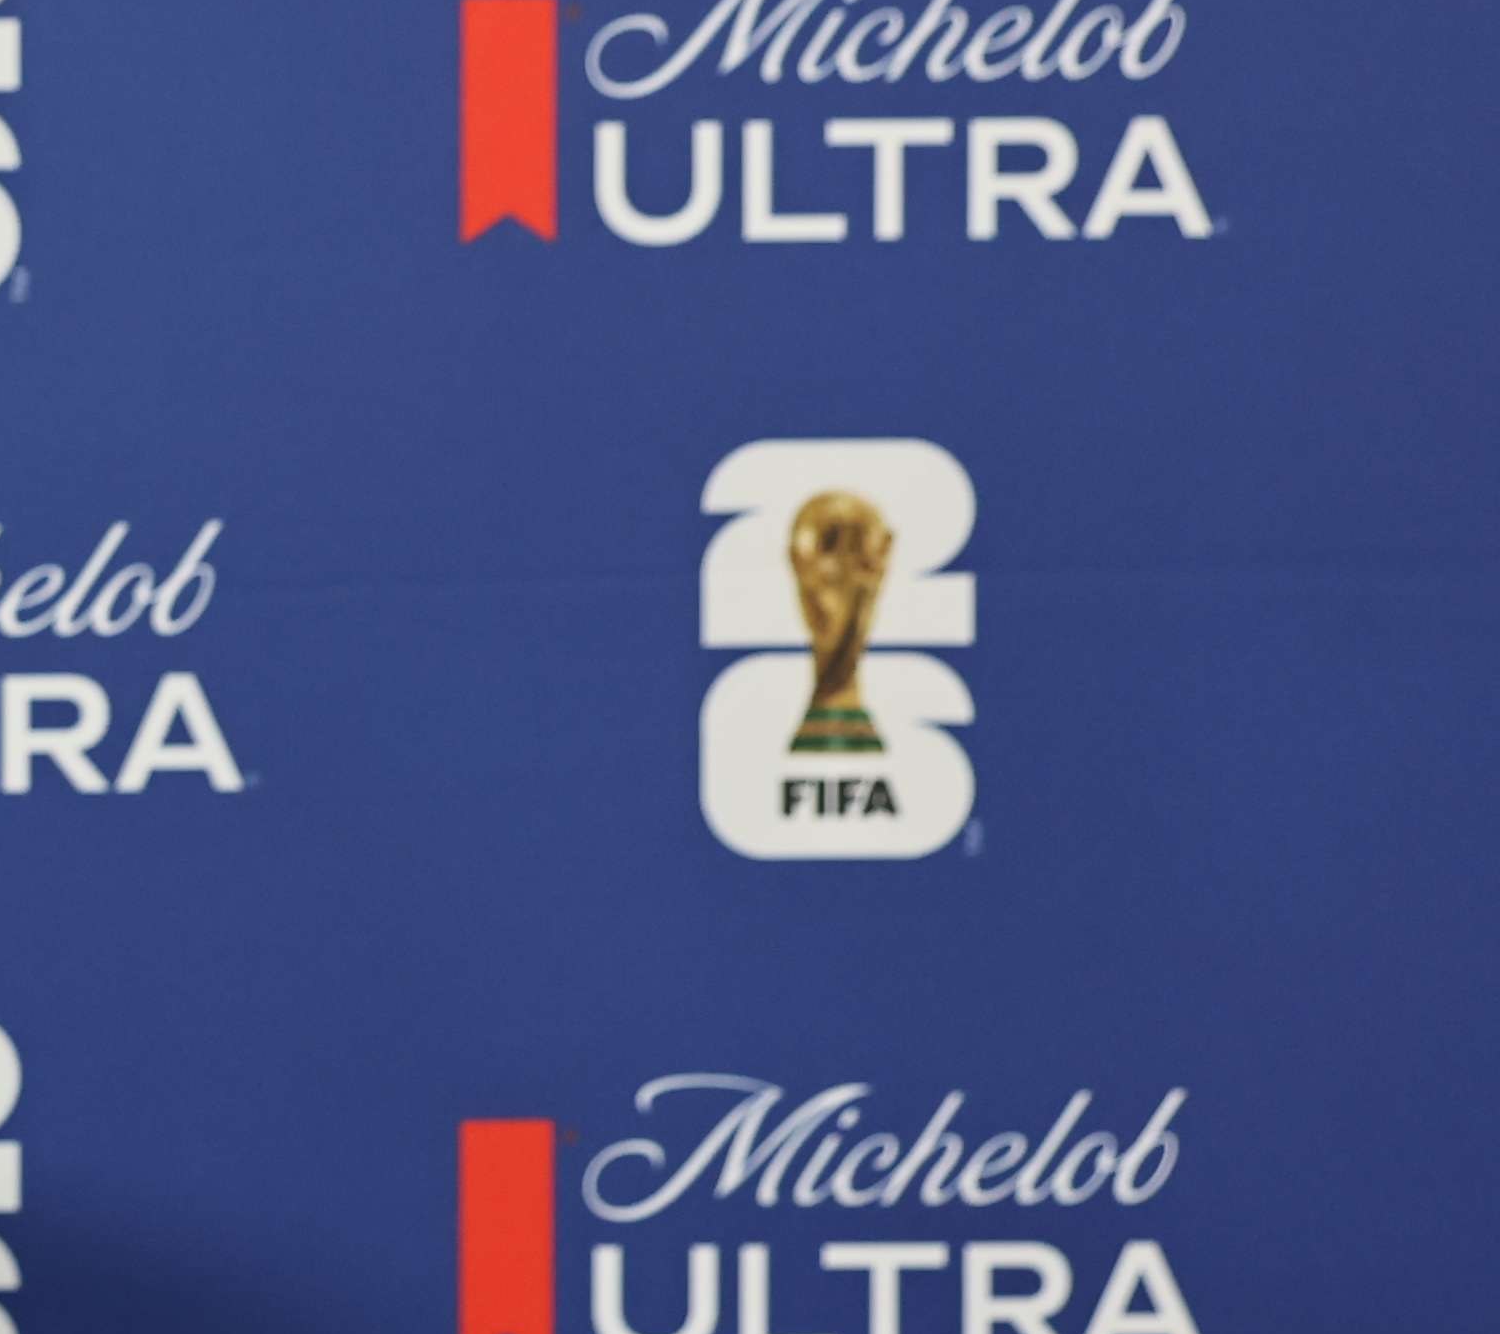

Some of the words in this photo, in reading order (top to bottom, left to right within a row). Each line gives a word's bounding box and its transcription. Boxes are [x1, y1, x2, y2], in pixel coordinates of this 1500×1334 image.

[595, 117, 1211, 245] ULTRA
[780, 777, 899, 818] FIFA
[585, 1076, 1184, 1221] Michelob
